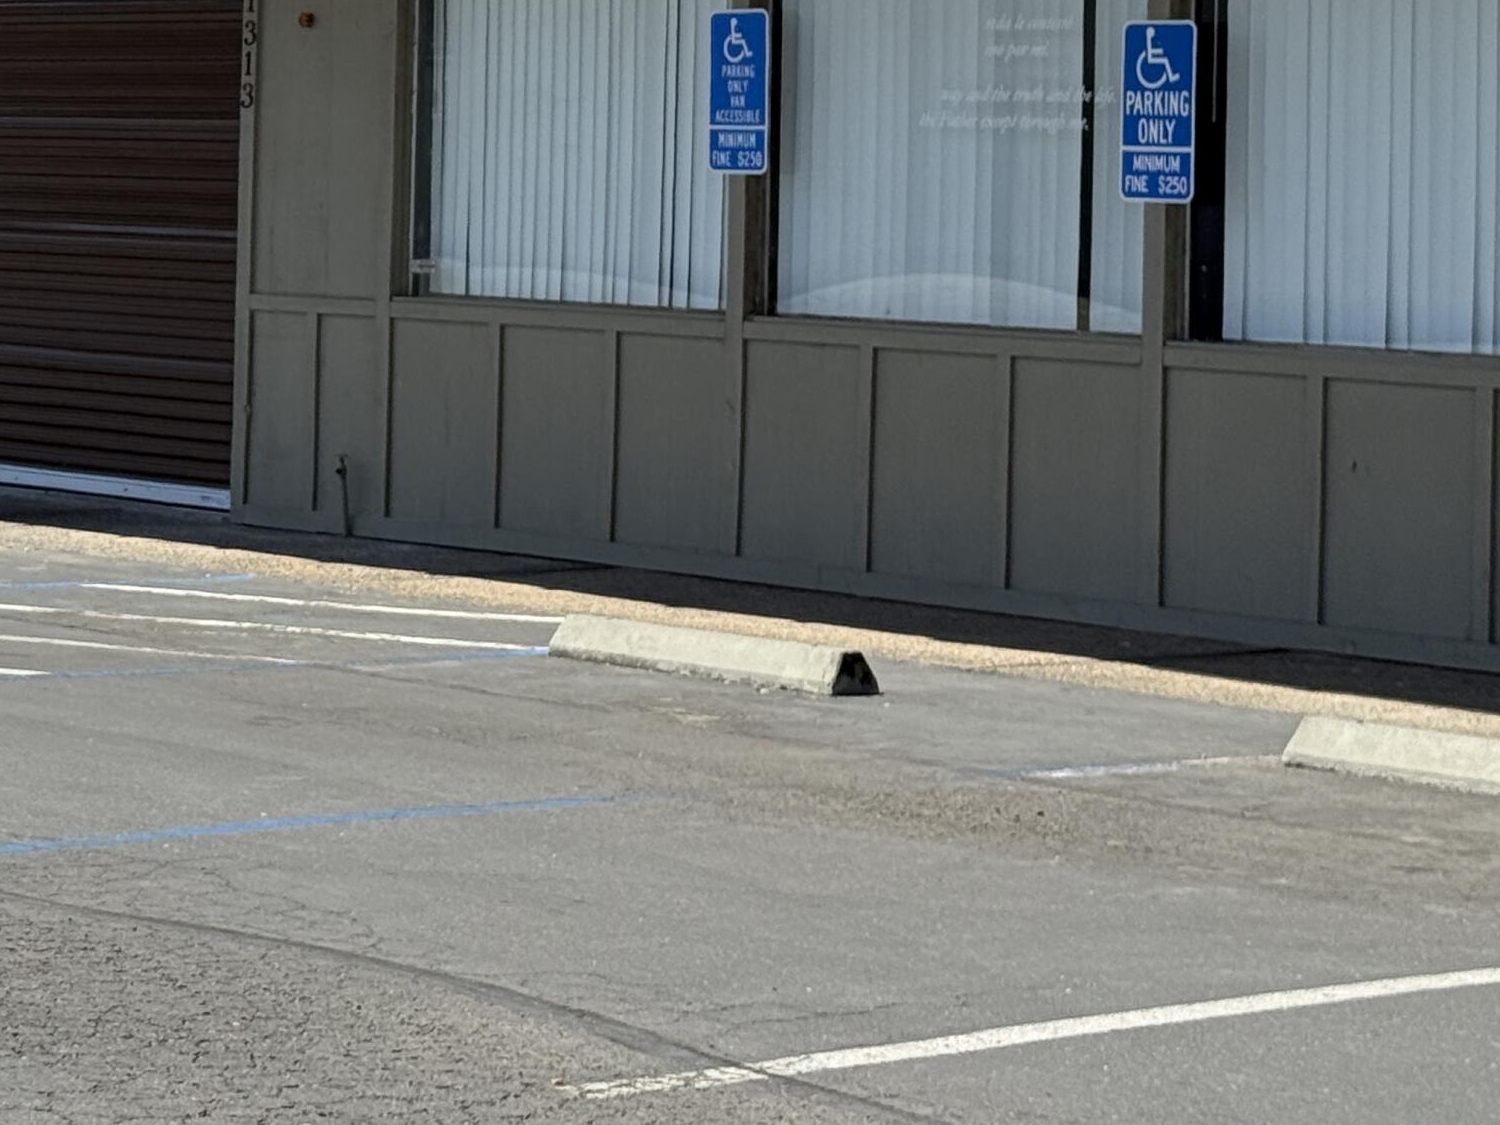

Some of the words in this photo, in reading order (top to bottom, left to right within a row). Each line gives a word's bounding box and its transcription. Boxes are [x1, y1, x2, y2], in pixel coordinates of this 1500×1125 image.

[721, 64, 756, 78] PARKING
[727, 79, 749, 93] ONLY
[729, 94, 746, 108] VAN
[1125, 90, 1190, 117] PARKING
[715, 109, 760, 124] ACCESSIBLE
[717, 131, 757, 148] MINIMUM
[1137, 119, 1176, 144] ONLY
[712, 150, 732, 167] FINE
[737, 151, 763, 167] $250
[1132, 154, 1181, 174] MINIMUM
[1125, 175, 1149, 193] FINE
[1158, 175, 1188, 194] $250
